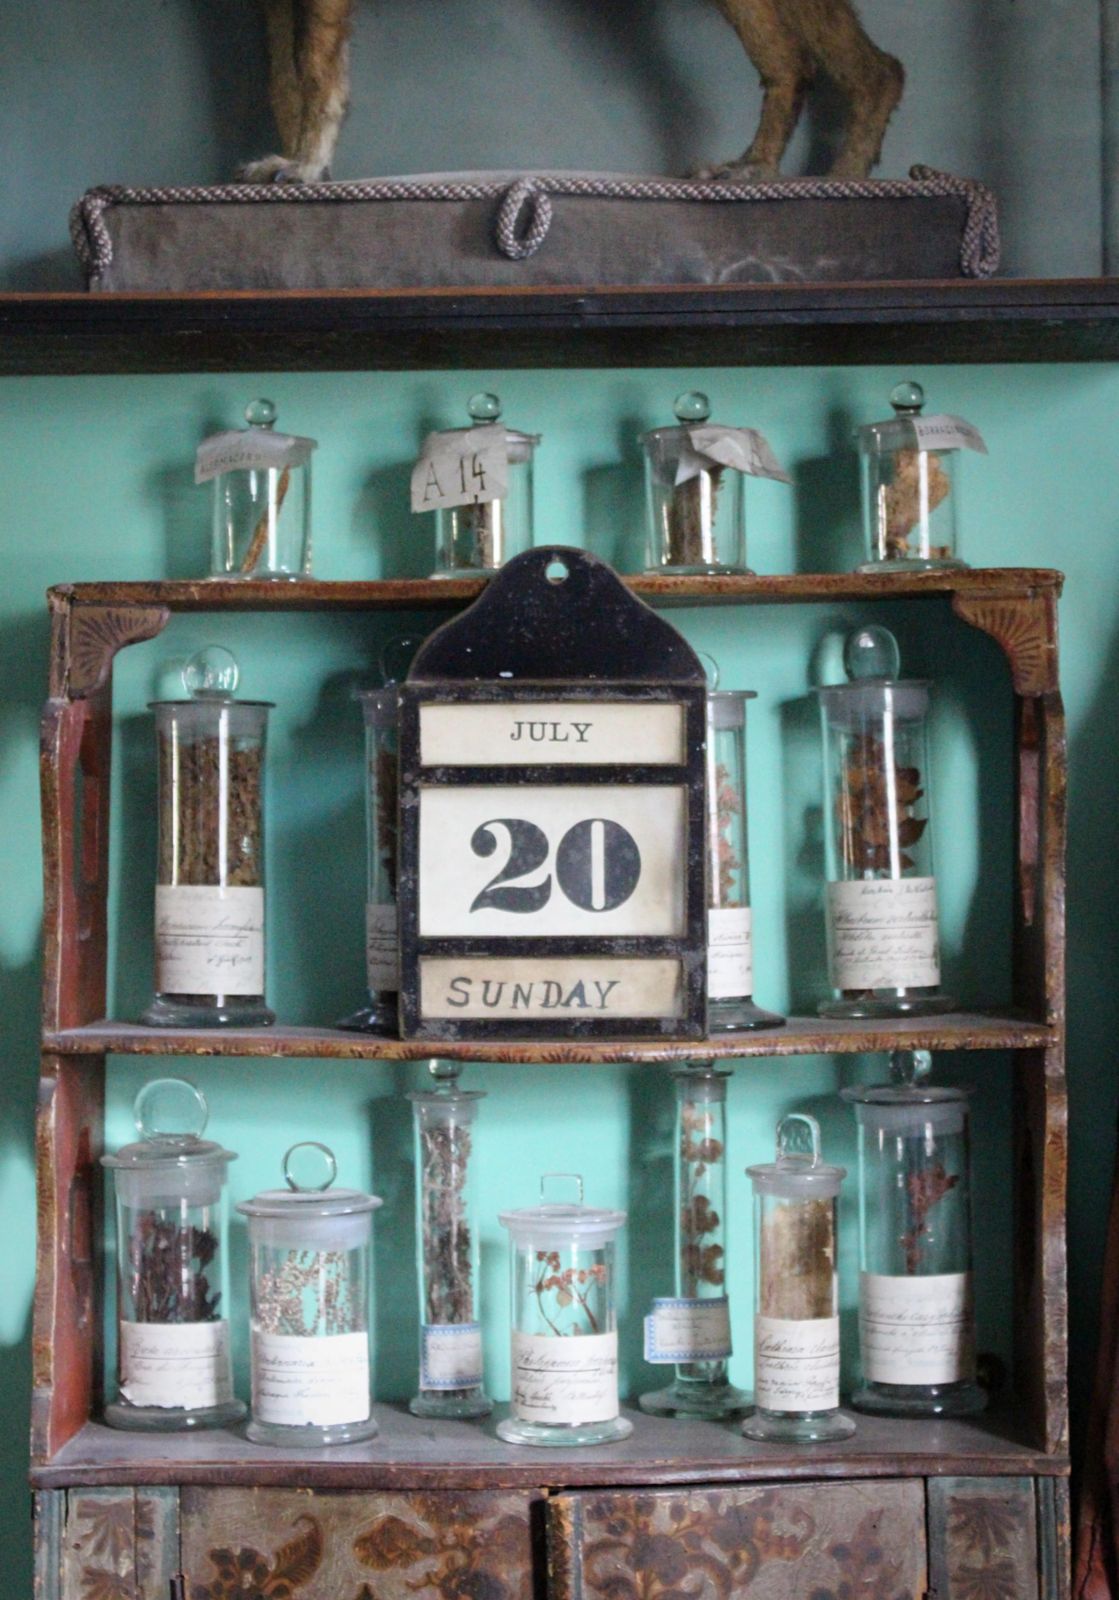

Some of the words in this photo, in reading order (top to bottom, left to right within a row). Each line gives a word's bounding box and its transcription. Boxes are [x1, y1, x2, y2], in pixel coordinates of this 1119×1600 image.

[423, 462, 445, 501] A
[459, 453, 487, 494] 14
[510, 721, 593, 743] JULY
[469, 818, 642, 914] 20
[446, 977, 621, 1010] SUNDAY
